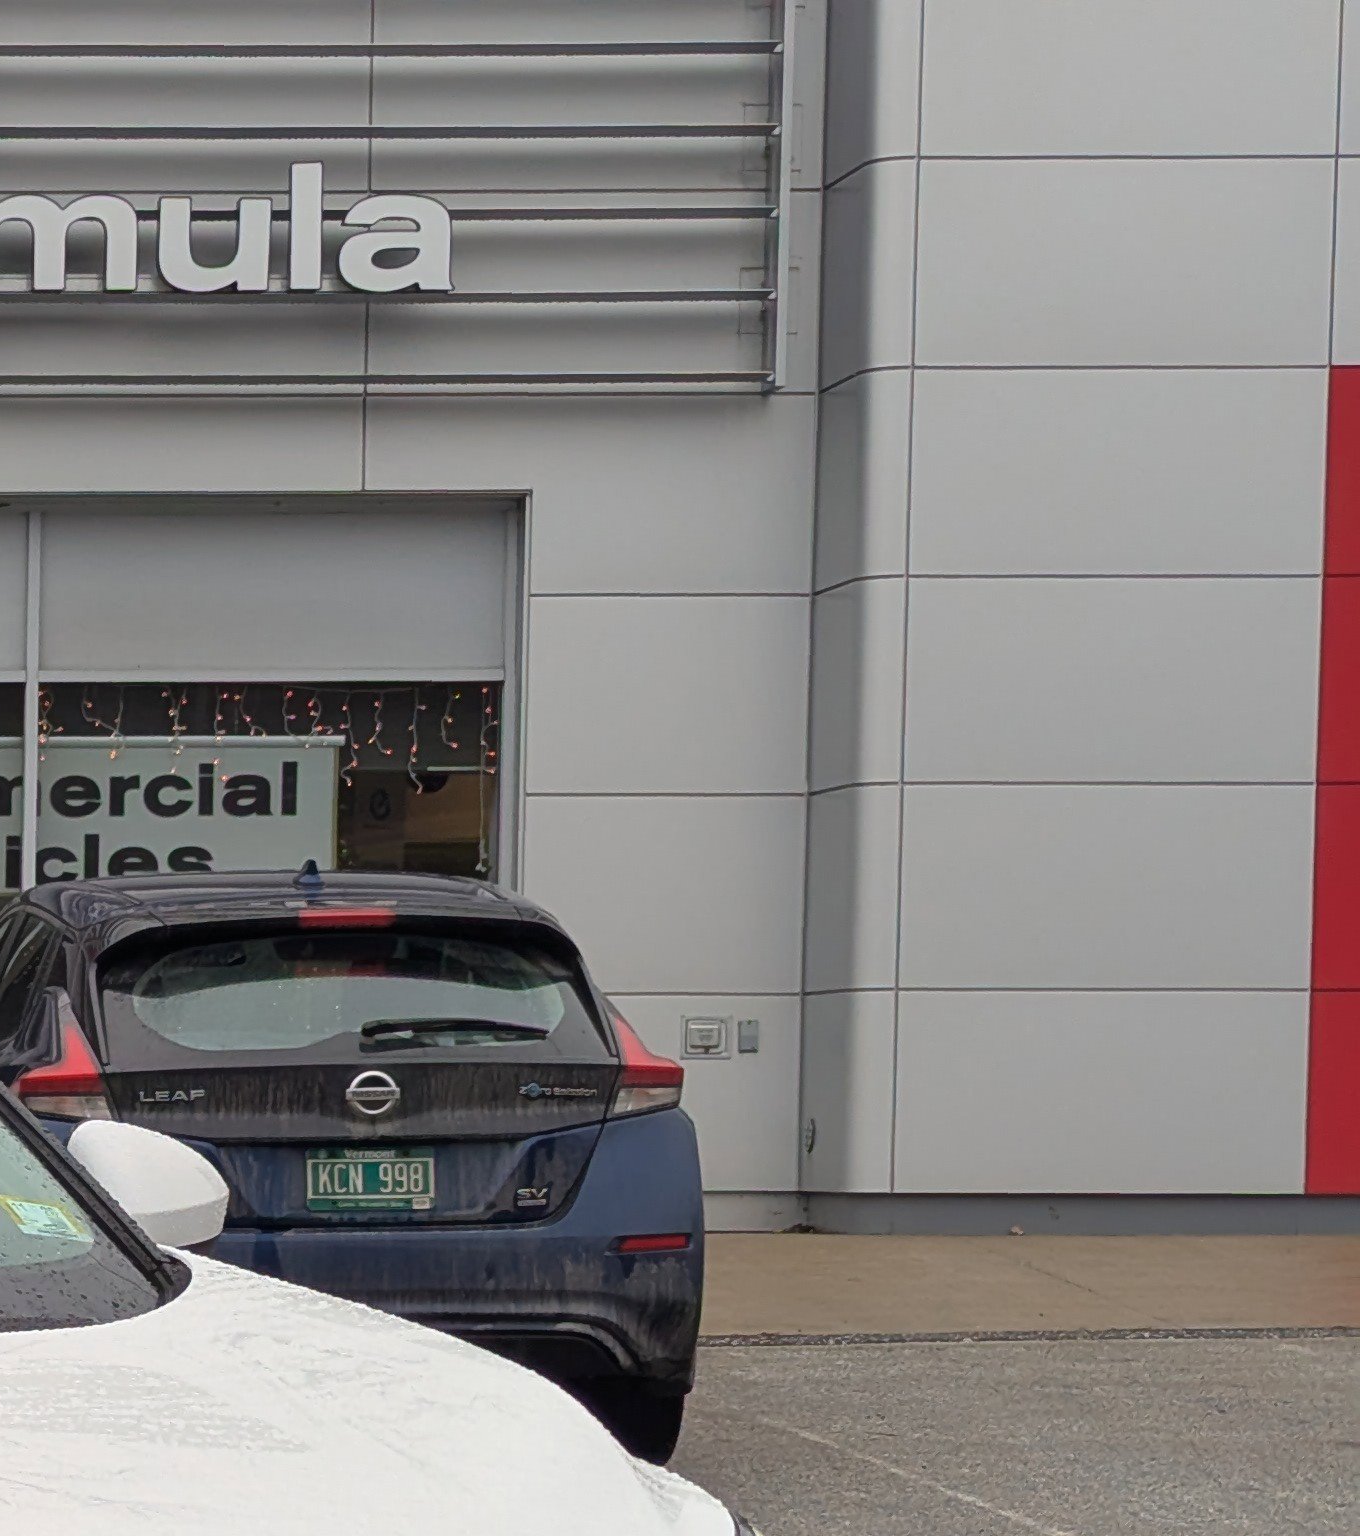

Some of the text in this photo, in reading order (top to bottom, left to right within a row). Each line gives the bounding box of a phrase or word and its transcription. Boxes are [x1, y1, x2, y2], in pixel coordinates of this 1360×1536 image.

[139, 1089, 206, 1102] LEAF
[319, 1163, 424, 1193] KCN 998
[517, 1188, 549, 1199] SV
